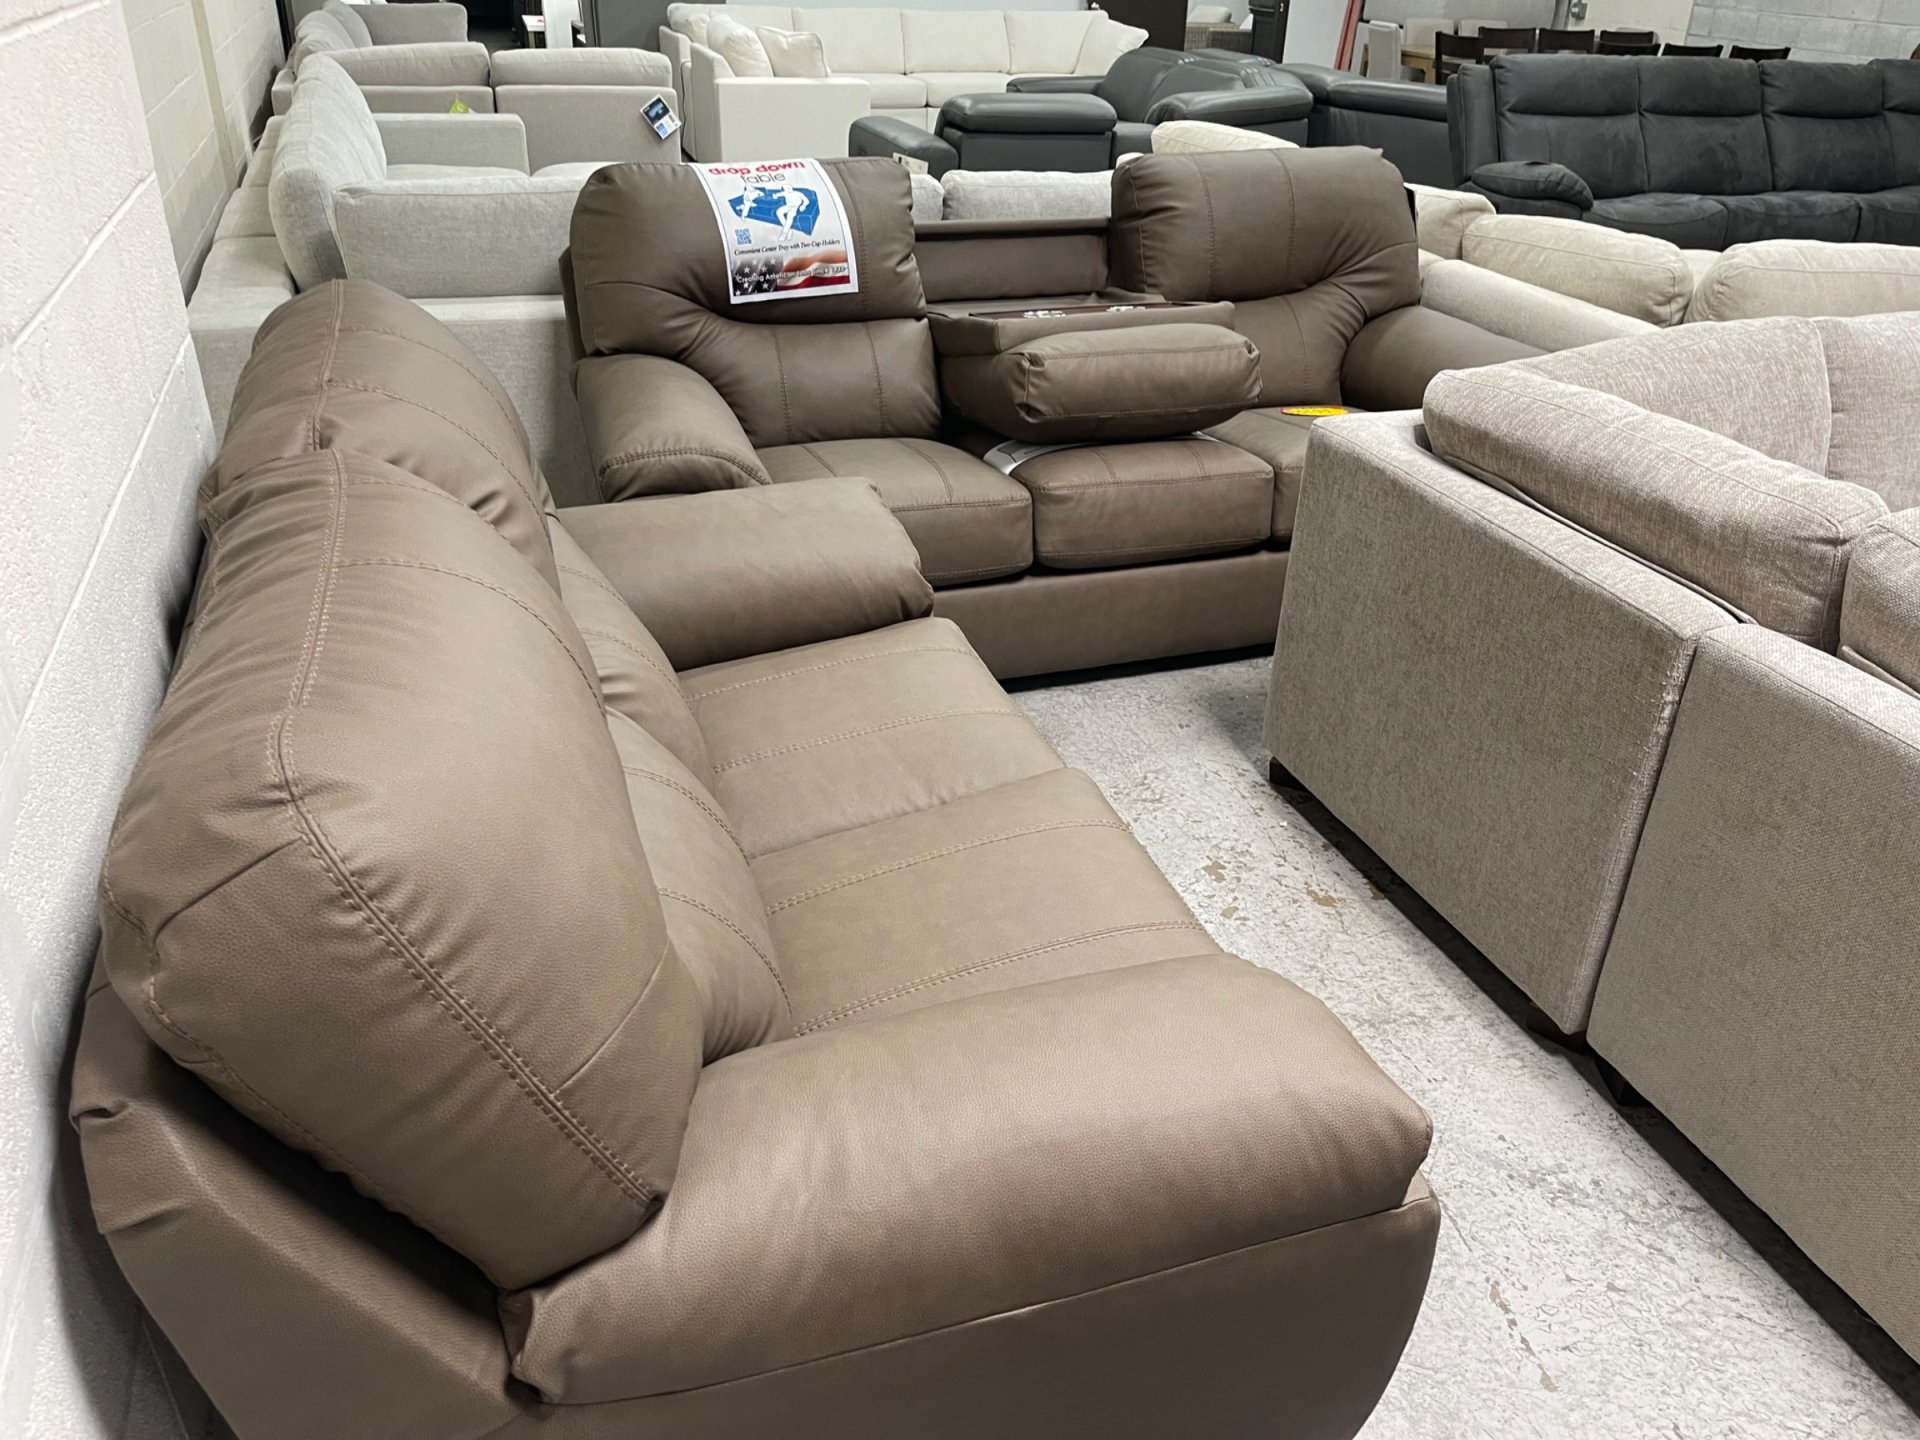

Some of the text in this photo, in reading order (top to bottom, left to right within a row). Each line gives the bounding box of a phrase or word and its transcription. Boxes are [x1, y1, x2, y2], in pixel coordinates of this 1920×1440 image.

[708, 161, 805, 175] drop down
[740, 172, 786, 183] table
[734, 247, 761, 256] Convenient
[761, 245, 777, 253] Center
[778, 243, 789, 251] Tray
[811, 241, 821, 249] Cup
[822, 239, 841, 247] Holders
[736, 274, 765, 284] Creating
